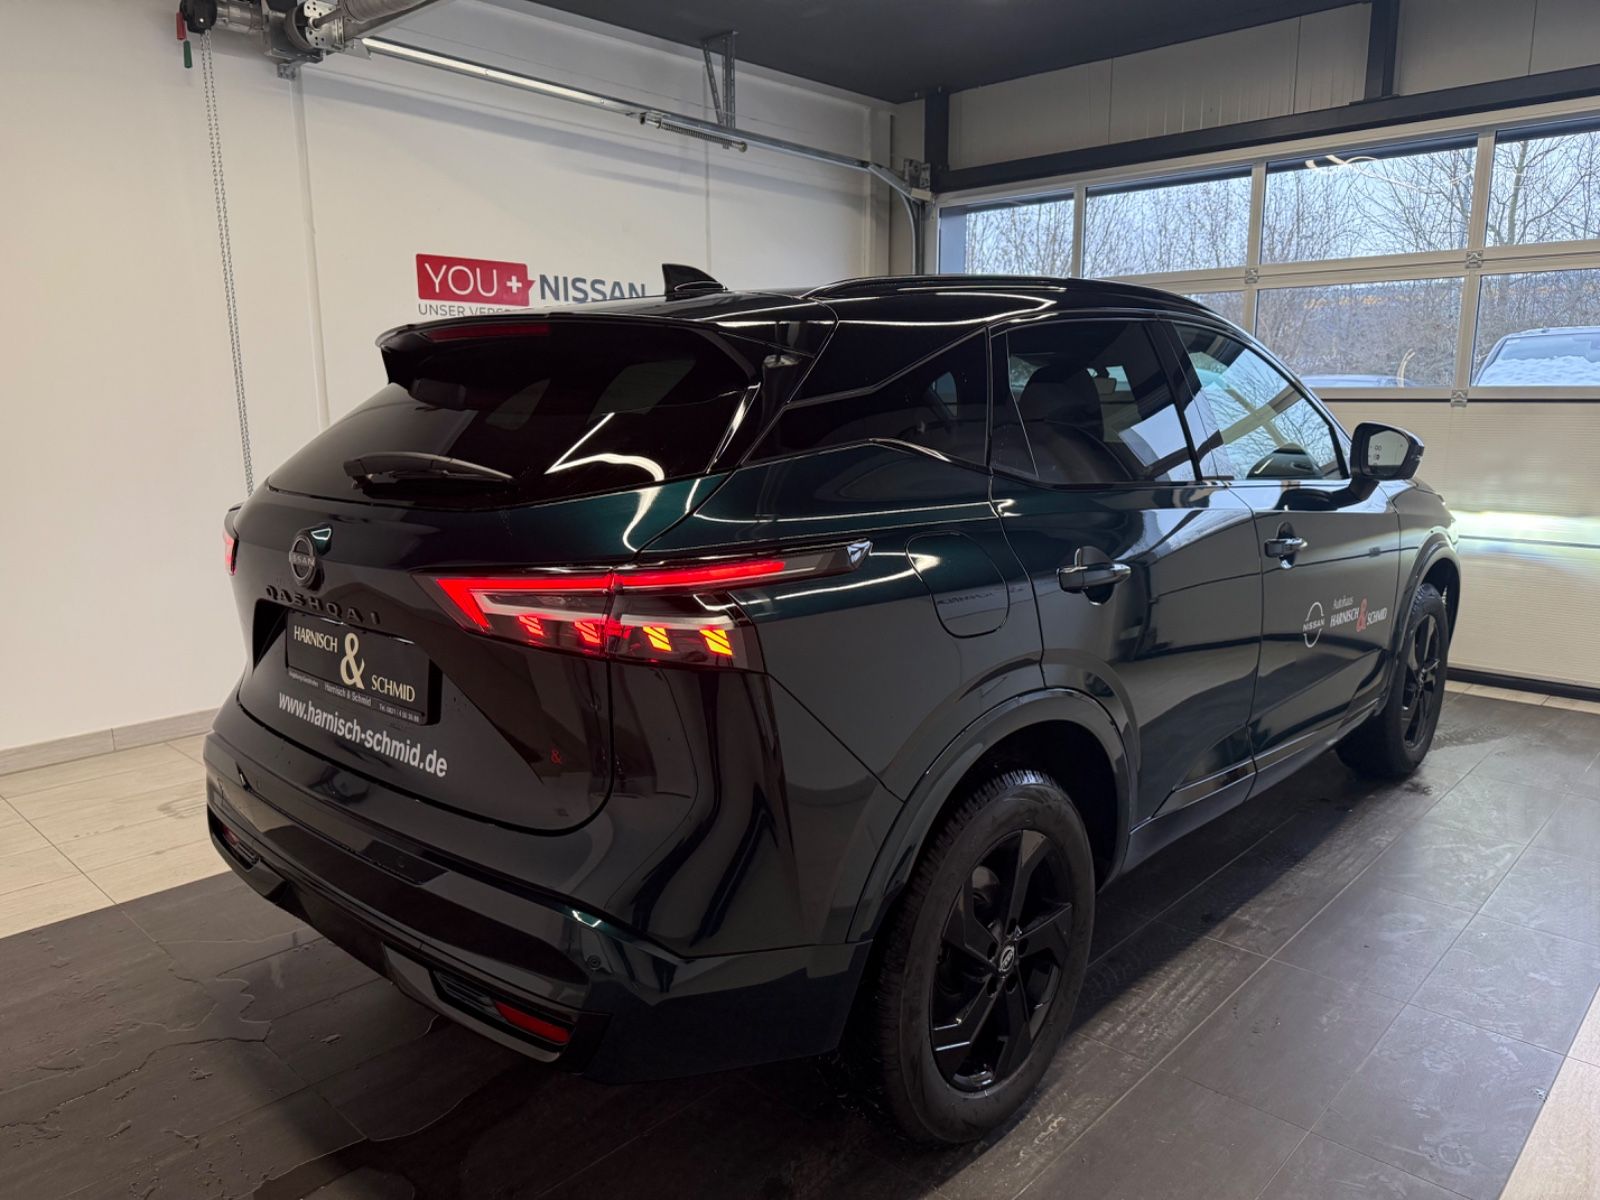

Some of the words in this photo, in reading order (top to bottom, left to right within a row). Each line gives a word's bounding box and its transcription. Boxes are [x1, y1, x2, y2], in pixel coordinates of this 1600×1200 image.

[539, 274, 645, 304] NISSAN
[418, 303, 466, 317] UNSER
[265, 584, 381, 625] QASHQAI
[1329, 607, 1360, 628] HARNISCH
[1367, 607, 1388, 626] SCHMID
[1302, 618, 1325, 632] NISSAN
[294, 625, 338, 653] HARNISCH
[340, 632, 366, 690] &
[371, 674, 416, 703] SCHMID
[278, 691, 448, 778] www.harnisch-schmid.de
